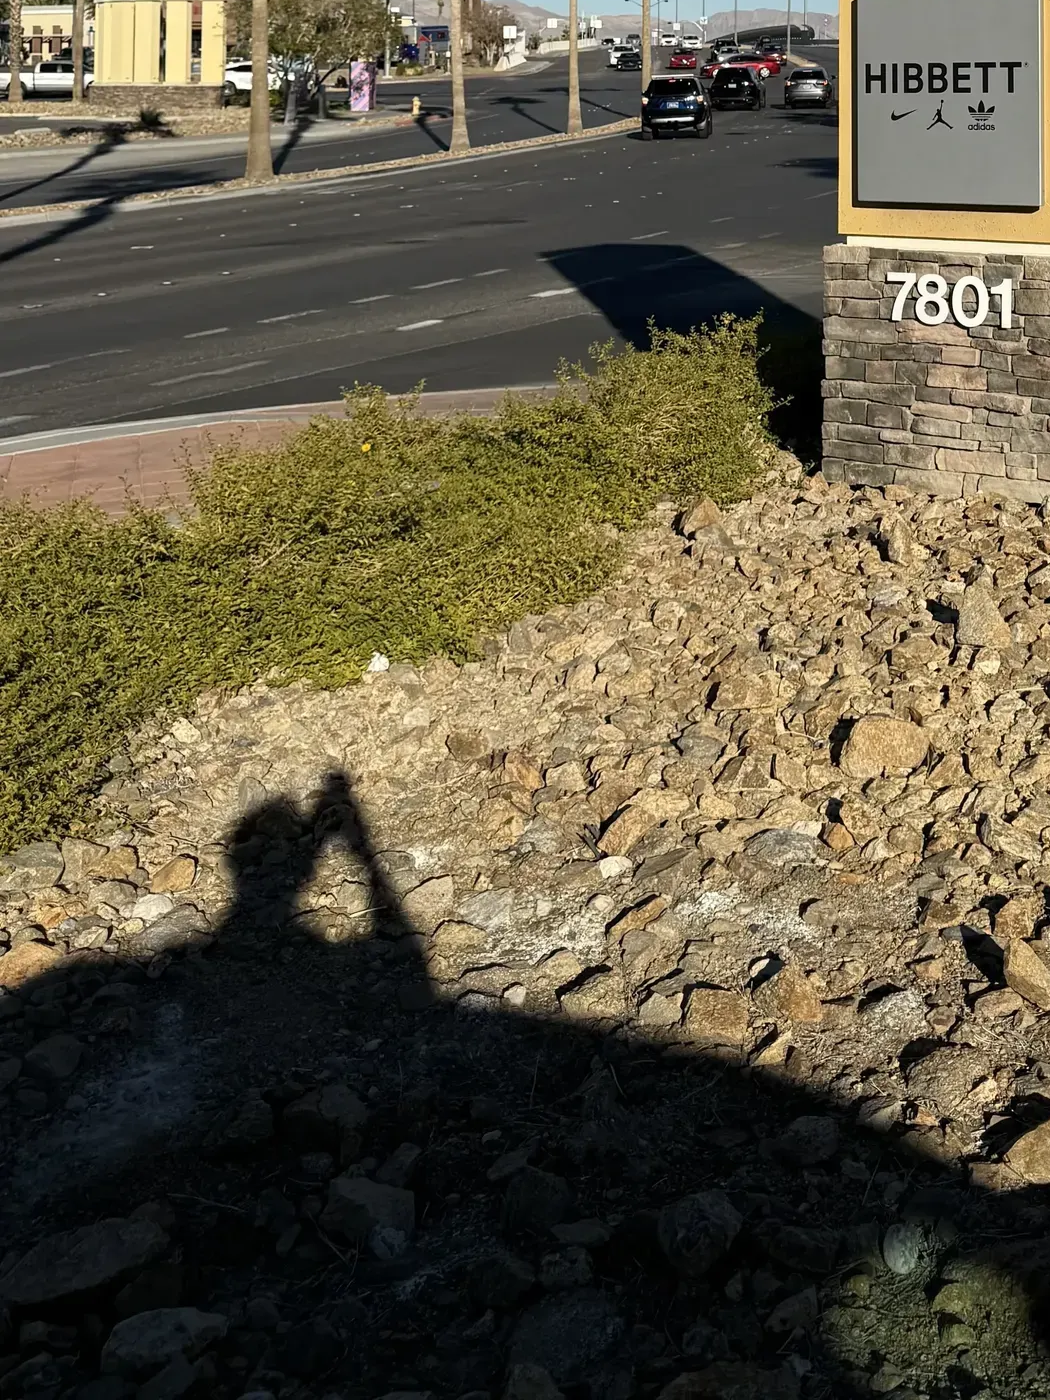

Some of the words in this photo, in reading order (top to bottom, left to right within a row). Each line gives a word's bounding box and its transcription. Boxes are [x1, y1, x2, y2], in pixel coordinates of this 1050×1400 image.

[865, 61, 1022, 94] HIBBETT
[967, 122, 996, 131] adidas
[886, 272, 1013, 329] 7801
